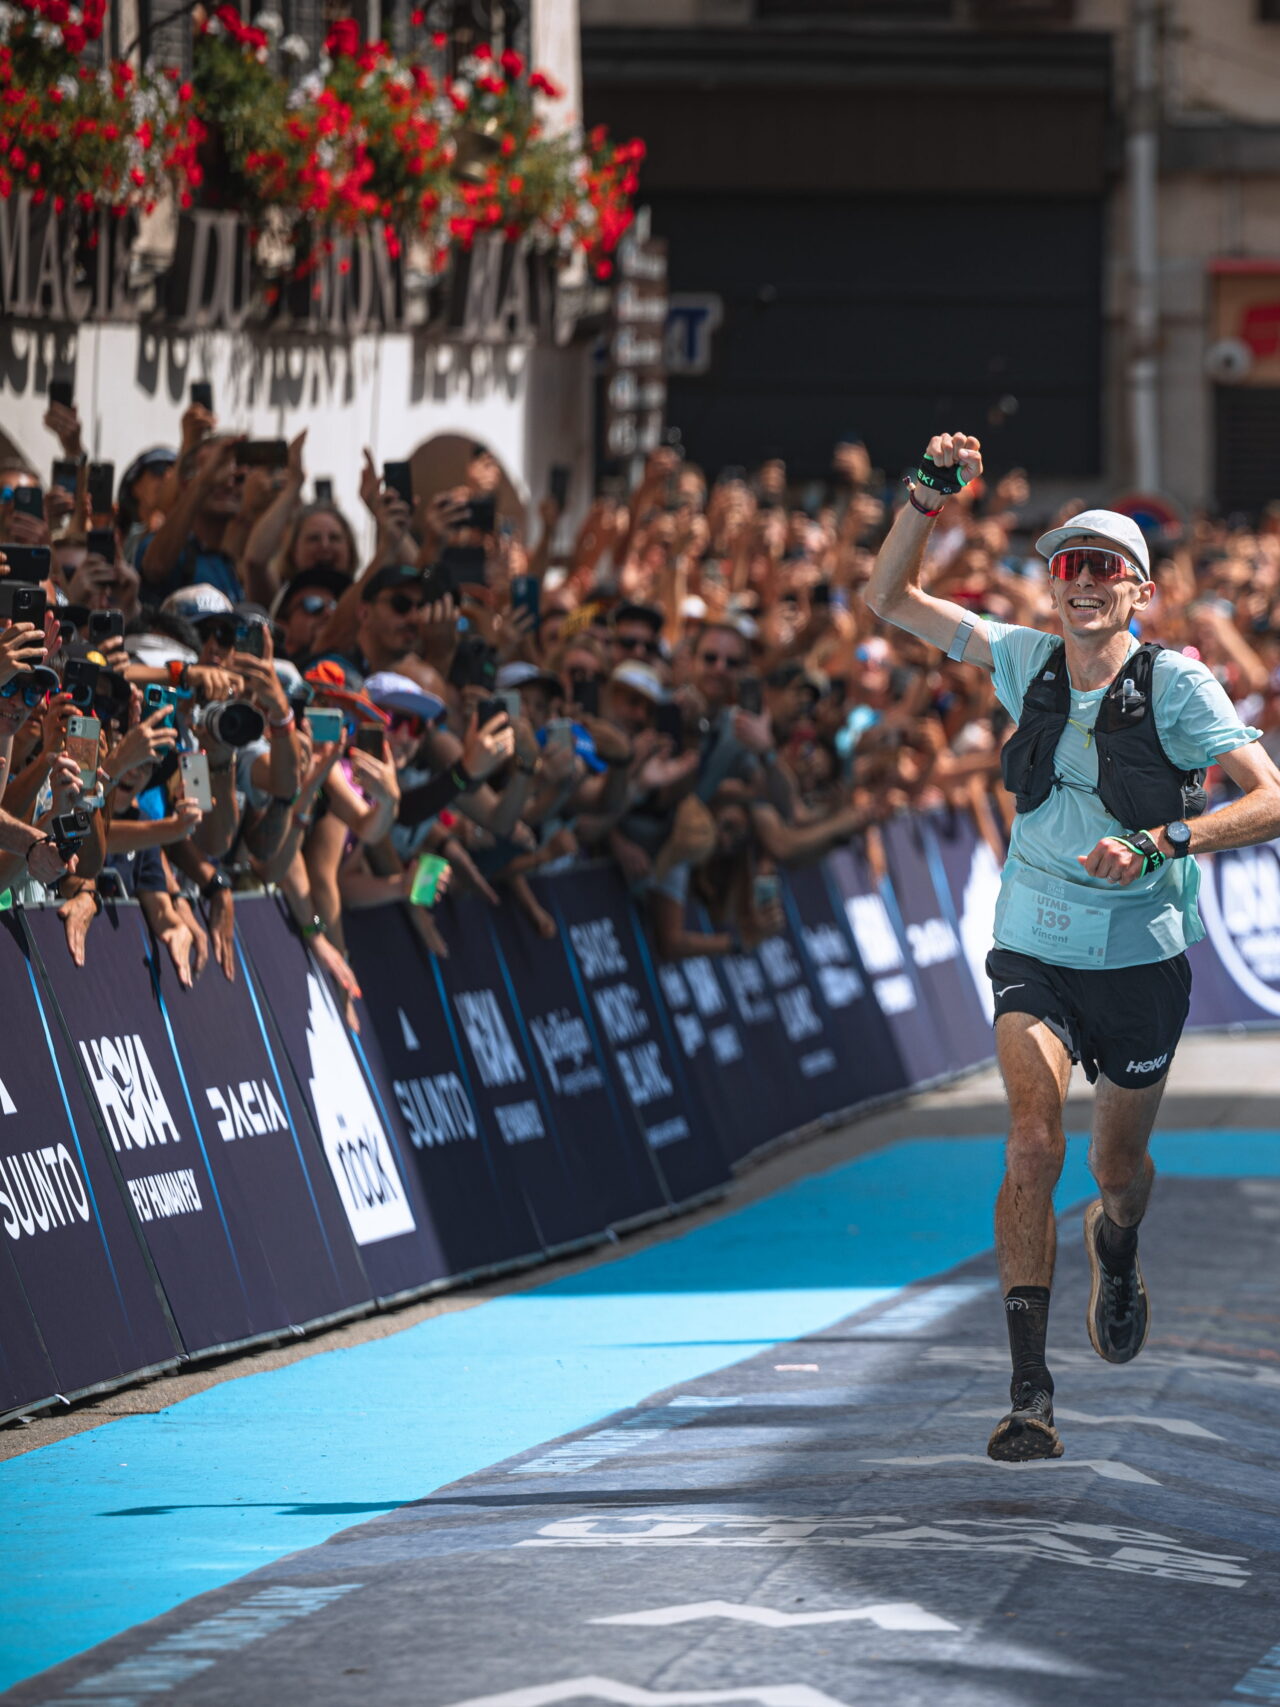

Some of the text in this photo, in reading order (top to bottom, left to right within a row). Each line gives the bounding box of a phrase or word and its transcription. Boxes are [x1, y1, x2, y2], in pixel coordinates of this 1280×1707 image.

[1036, 907, 1071, 931] 139
[1037, 894, 1069, 912] UTMB
[1031, 926, 1068, 944] Vincent
[1126, 1052, 1168, 1073] HOKA
[78, 1033, 181, 1153] HOKA
[205, 1078, 289, 1143] DACIA
[393, 1071, 478, 1150] SUUNTO
[0, 1142, 90, 1240] SUUNTO
[126, 1167, 203, 1222] FLY HUMAN FLY
